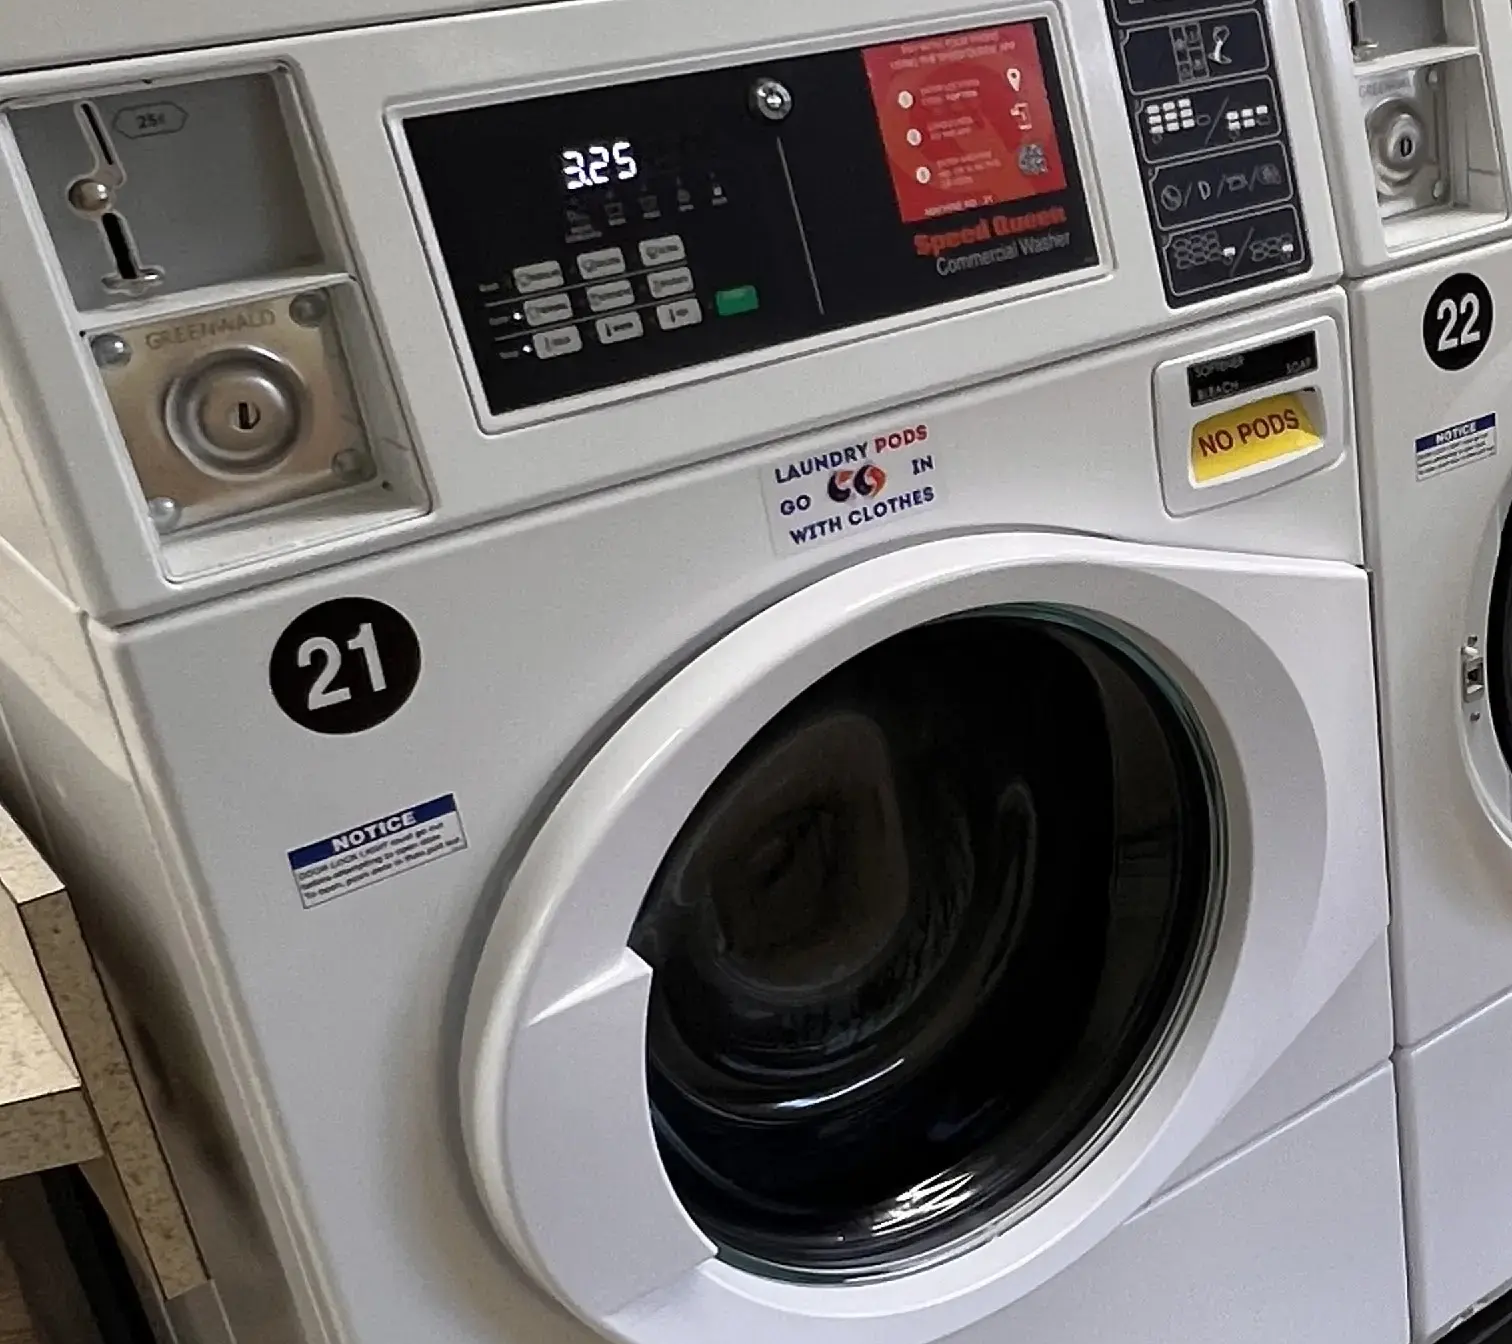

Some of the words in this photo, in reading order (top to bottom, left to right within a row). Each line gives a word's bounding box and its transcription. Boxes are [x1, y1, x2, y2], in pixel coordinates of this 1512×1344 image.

[913, 216, 991, 256] Speed
[992, 206, 1068, 238] Queen
[936, 241, 1020, 277] Commercial
[1018, 230, 1071, 256] Washer
[145, 308, 276, 350] GREENWALD
[1436, 293, 1481, 352] 22
[774, 441, 869, 484] LAUNDRY
[874, 424, 928, 454] PODS
[1198, 429, 1234, 458] NO
[1237, 409, 1300, 445] PODS
[1435, 421, 1477, 445] NOTICE
[780, 494, 812, 516] GO
[911, 455, 934, 476] IN
[788, 516, 843, 545] WITH
[848, 486, 935, 526] CLOTHES
[297, 622, 387, 711] 21
[331, 812, 417, 853] NOTICE
